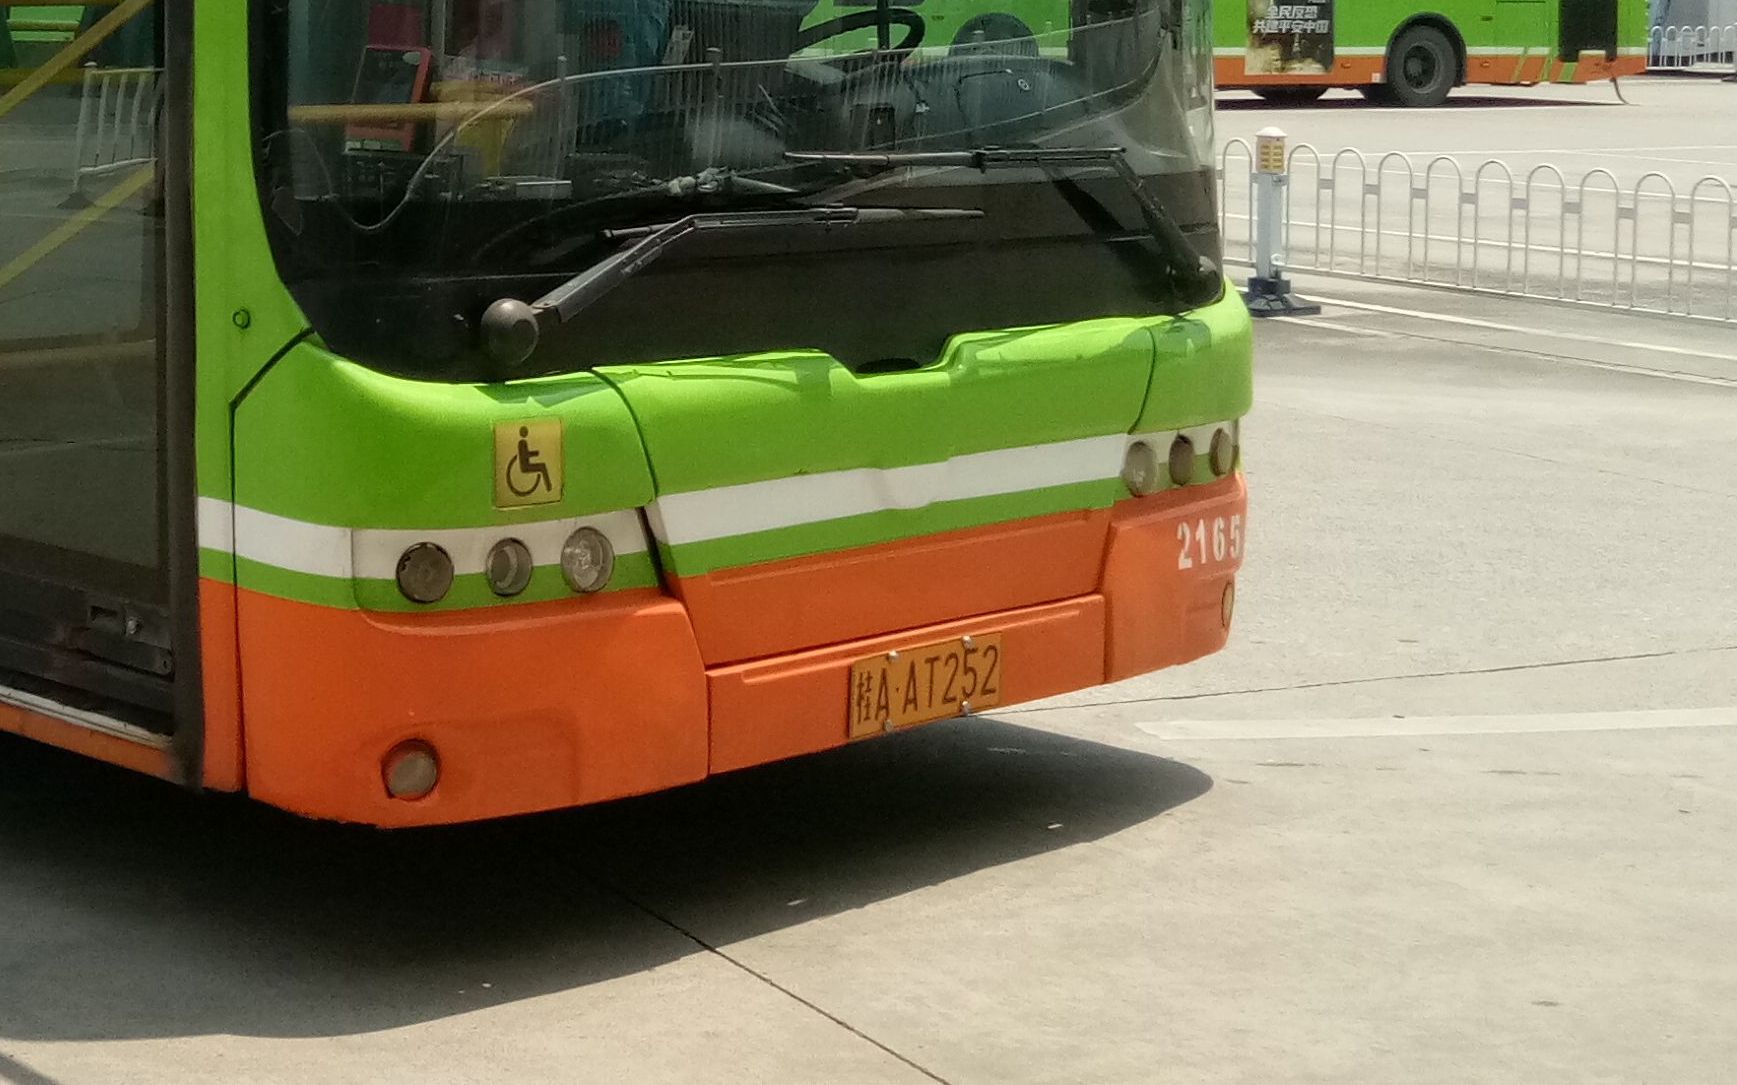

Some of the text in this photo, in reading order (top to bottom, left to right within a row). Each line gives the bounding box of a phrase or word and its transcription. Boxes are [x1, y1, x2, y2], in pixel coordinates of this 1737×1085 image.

[1264, 5, 1319, 20] 全民反恐
[1252, 19, 1330, 34] 共建平安中国
[1177, 514, 1242, 570] 2165
